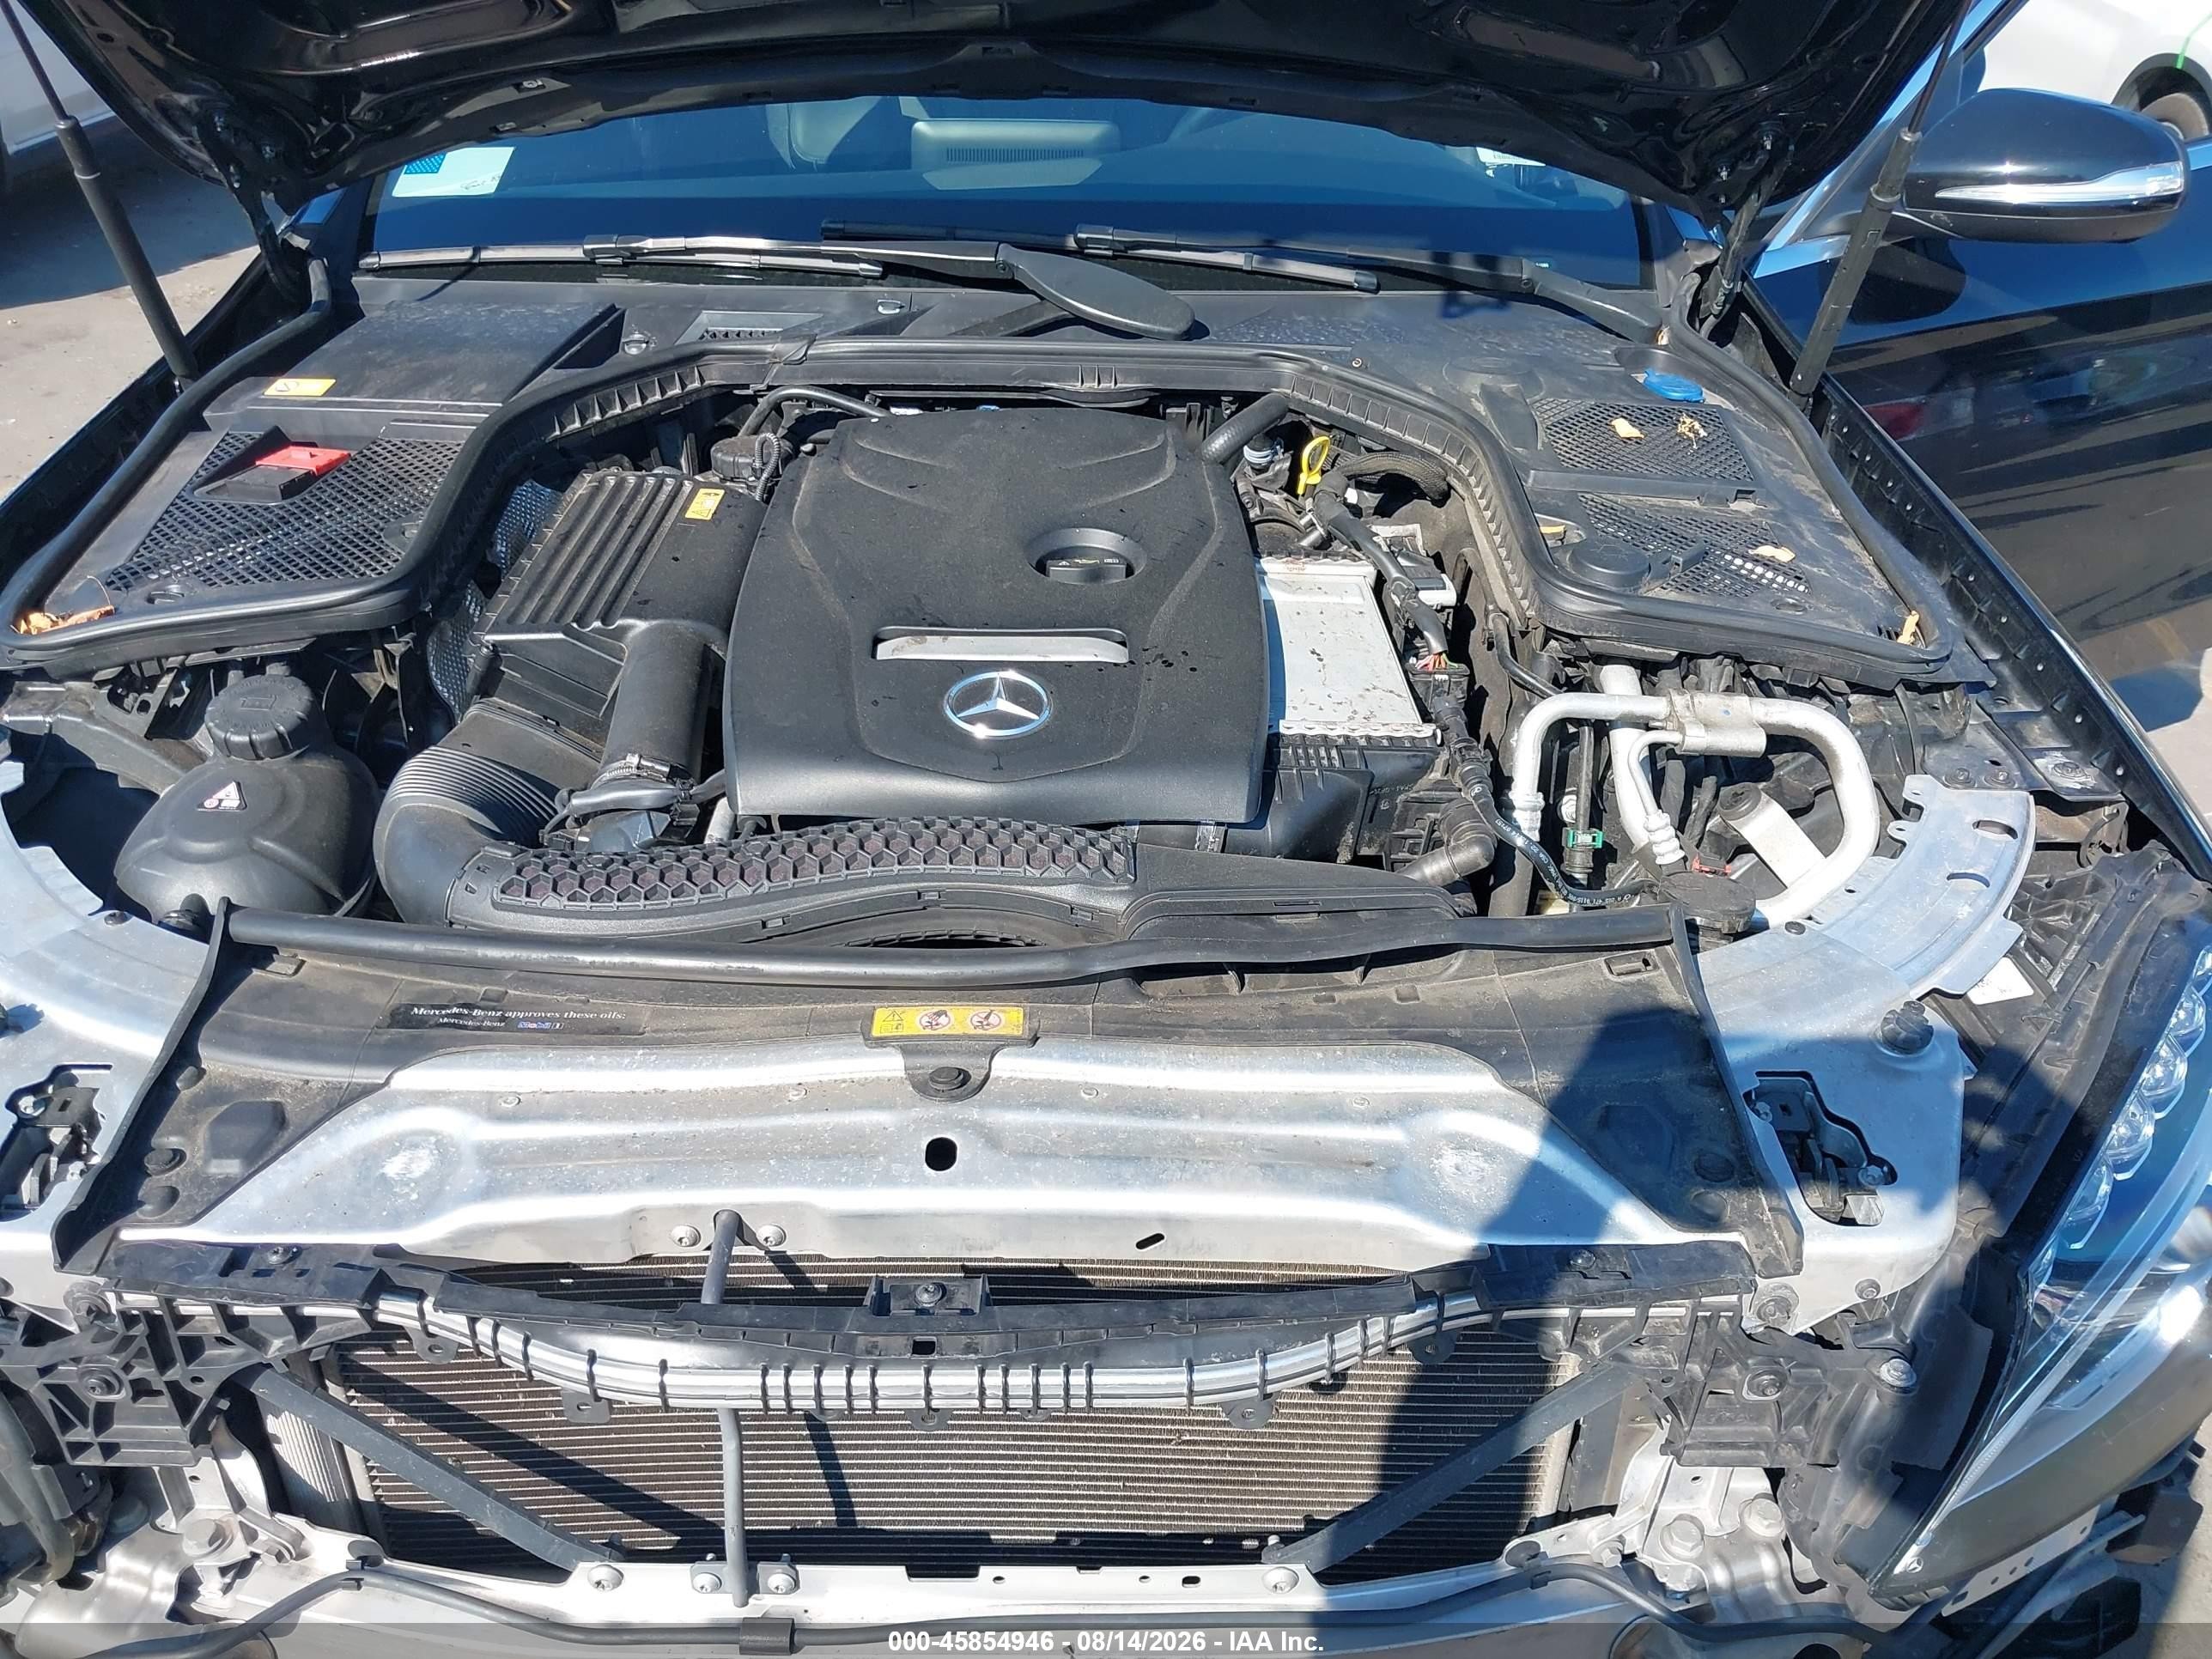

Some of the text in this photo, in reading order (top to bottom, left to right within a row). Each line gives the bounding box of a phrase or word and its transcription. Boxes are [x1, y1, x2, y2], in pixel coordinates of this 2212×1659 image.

[411, 1007, 503, 1017] Mercedes-Benz
[504, 1011, 561, 1019] approves
[563, 1011, 598, 1019] these
[438, 1017, 506, 1027] Mercedes-Benz
